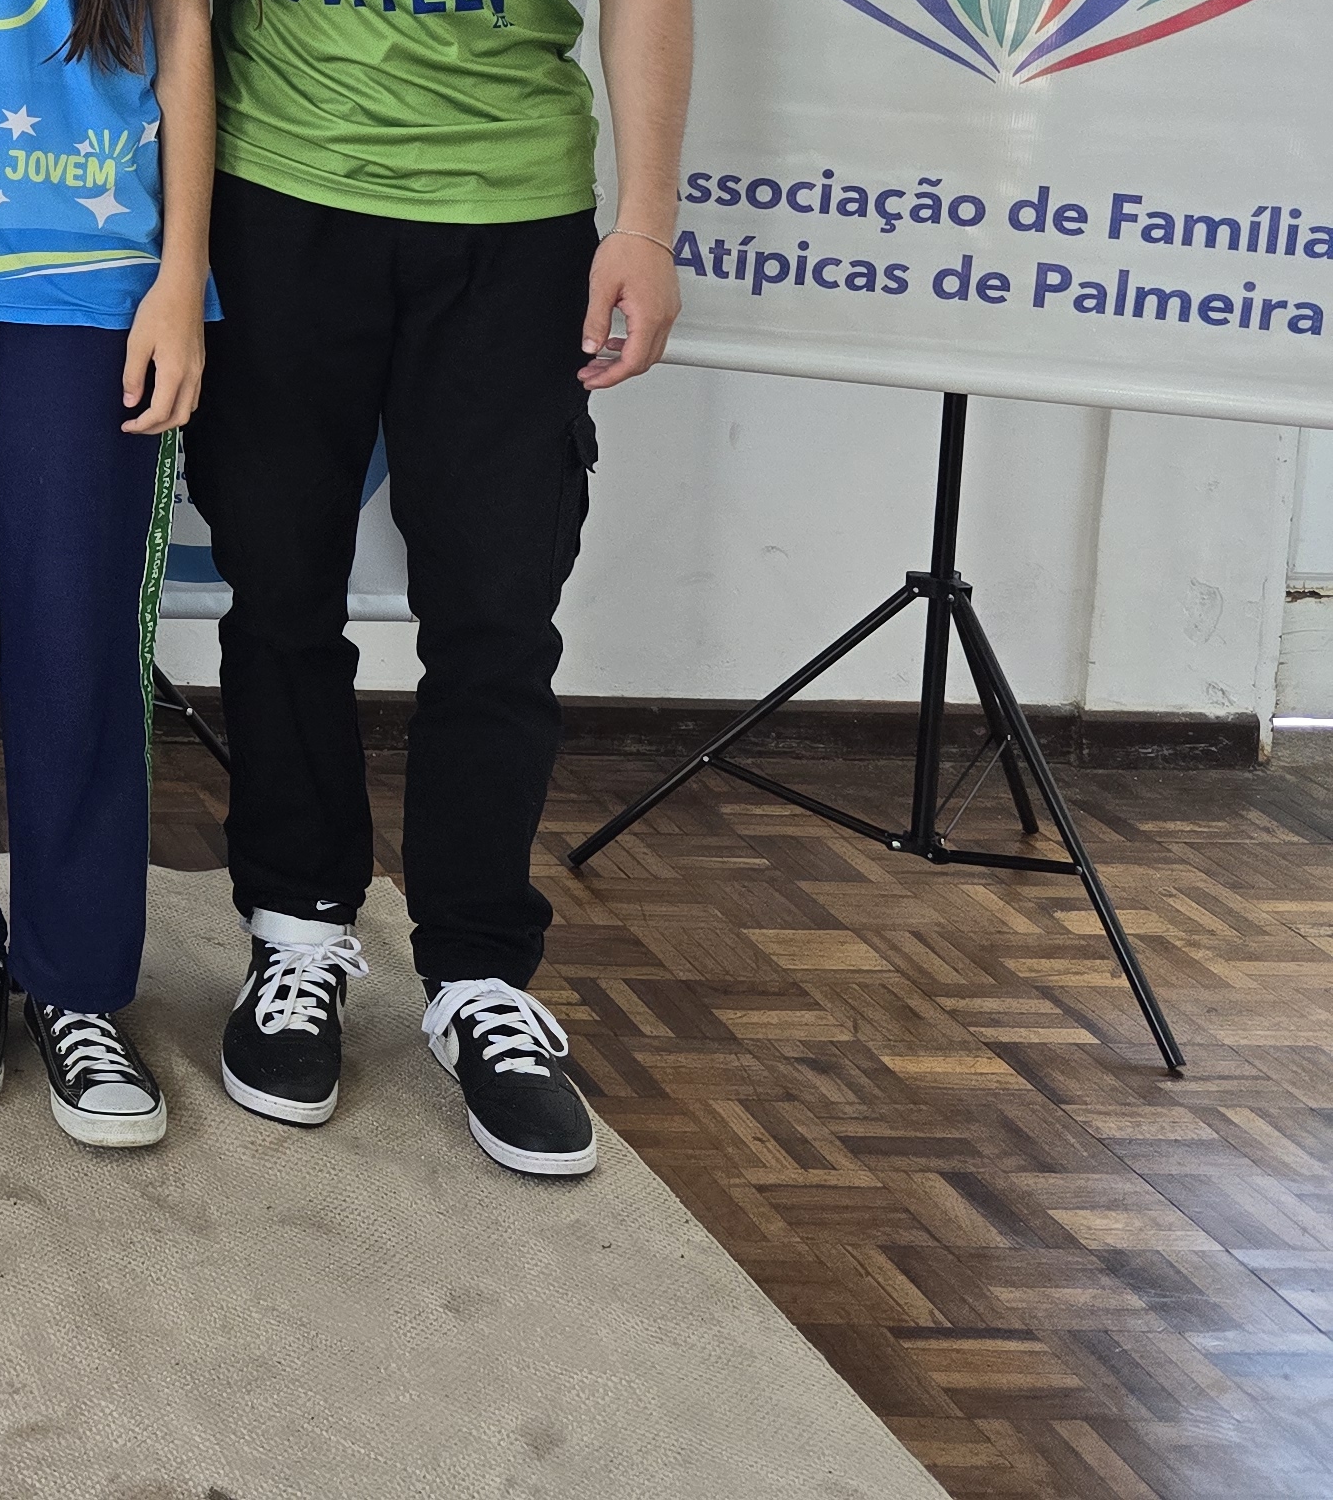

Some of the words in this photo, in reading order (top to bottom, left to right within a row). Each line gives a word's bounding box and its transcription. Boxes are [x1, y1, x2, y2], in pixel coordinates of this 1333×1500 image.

[5, 149, 116, 189] JOVEM
[676, 168, 986, 233] ssociação
[1007, 185, 1089, 236] de
[673, 229, 910, 296] Atípicas
[931, 254, 1011, 304] de
[1032, 261, 1324, 336] Palmeira
